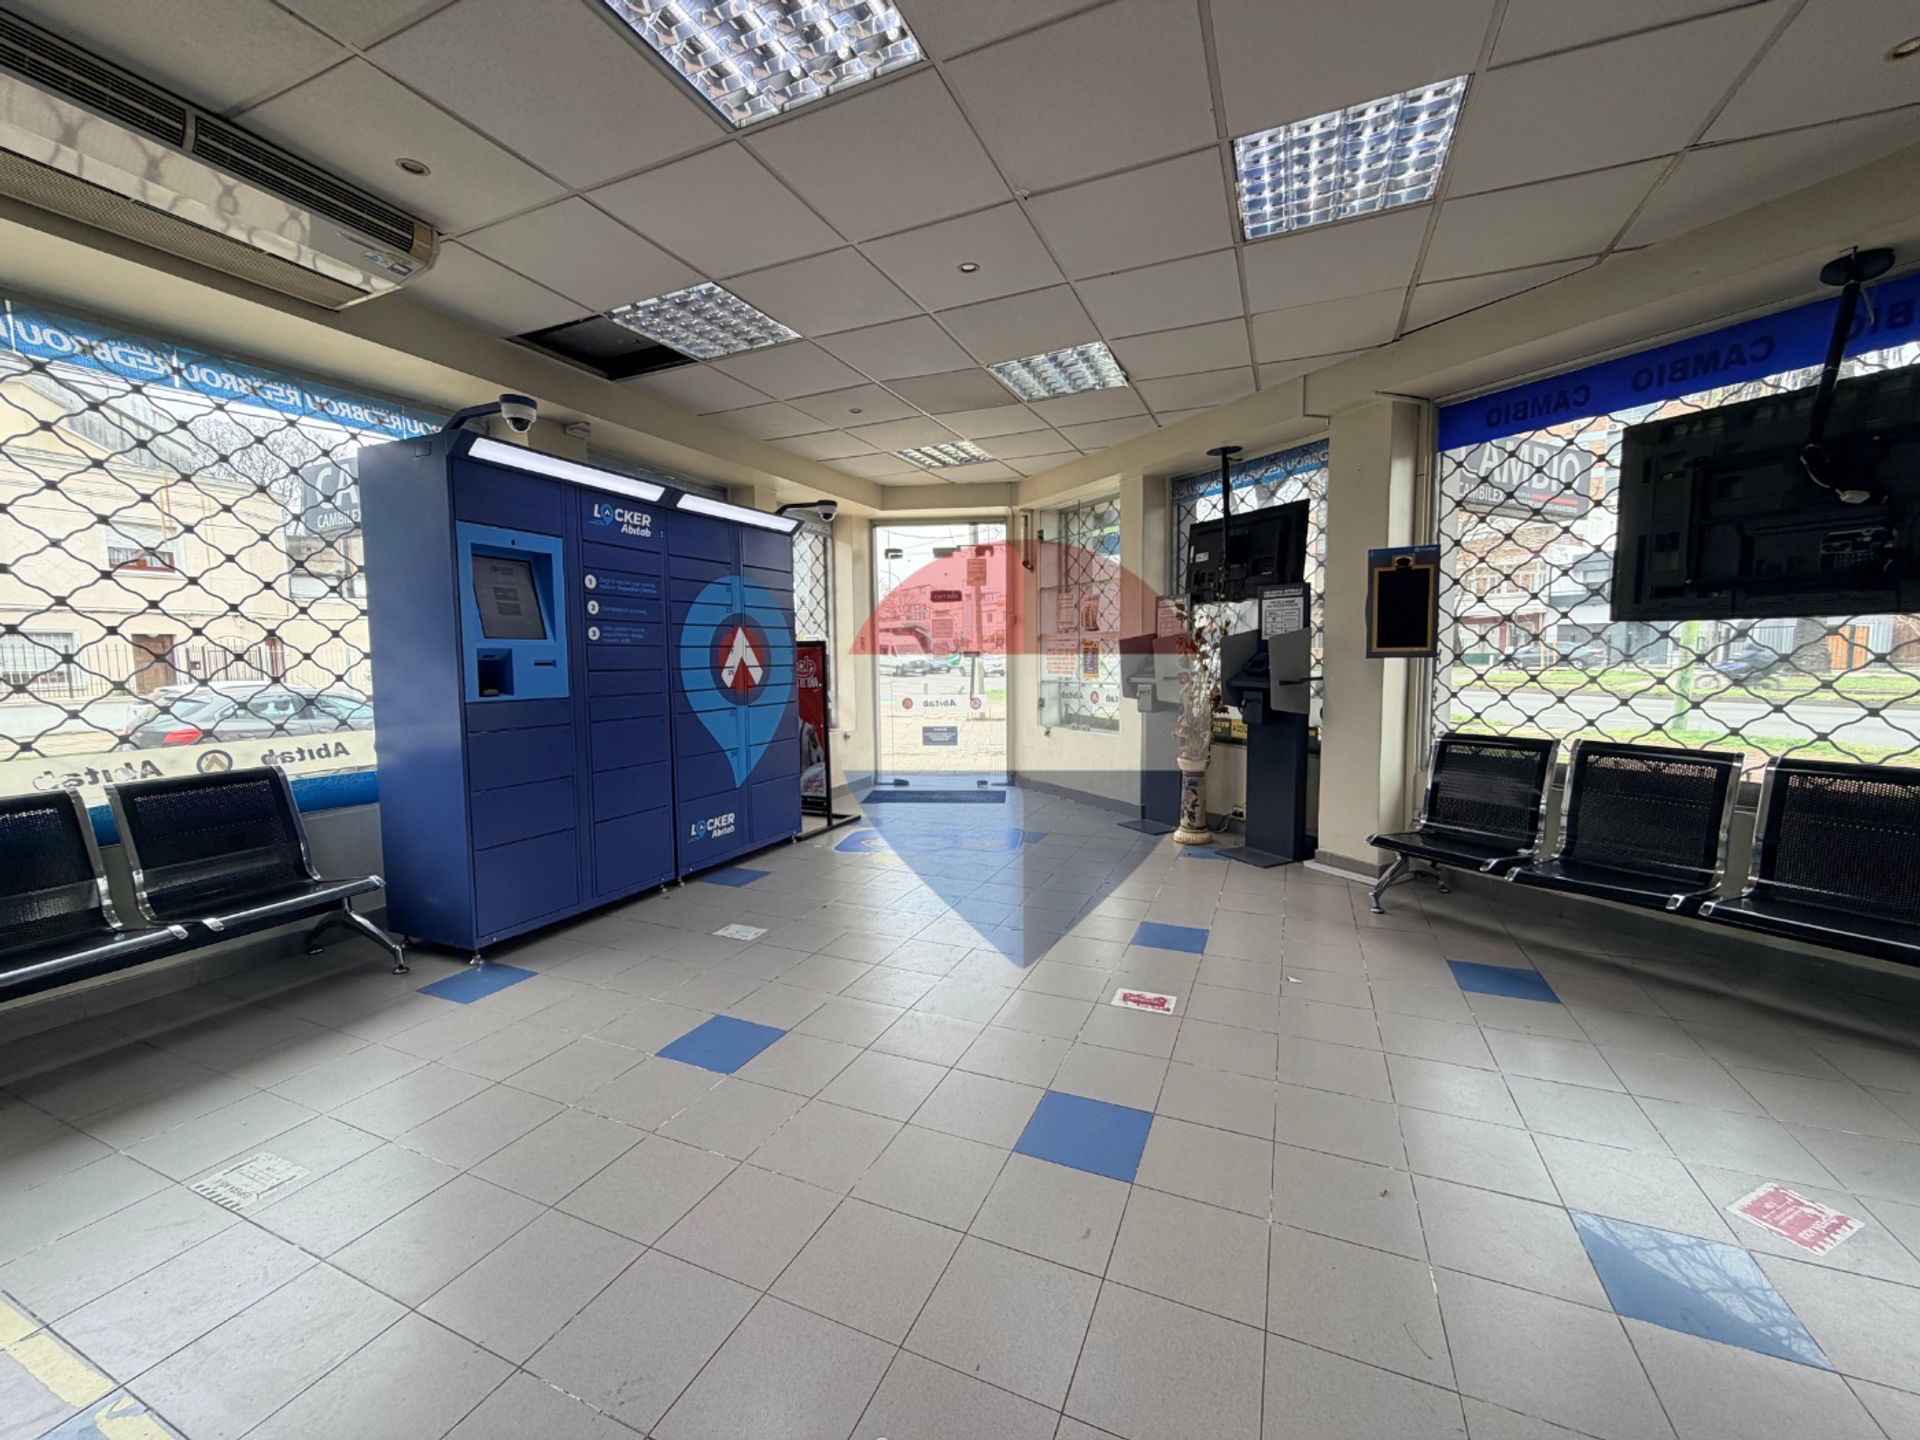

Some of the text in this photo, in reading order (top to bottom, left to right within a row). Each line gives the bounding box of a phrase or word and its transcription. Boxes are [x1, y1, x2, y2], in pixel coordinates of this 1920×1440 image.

[594, 503, 652, 528] LOCKER
[621, 523, 652, 538] Abitab
[691, 812, 735, 837] LOCKER
